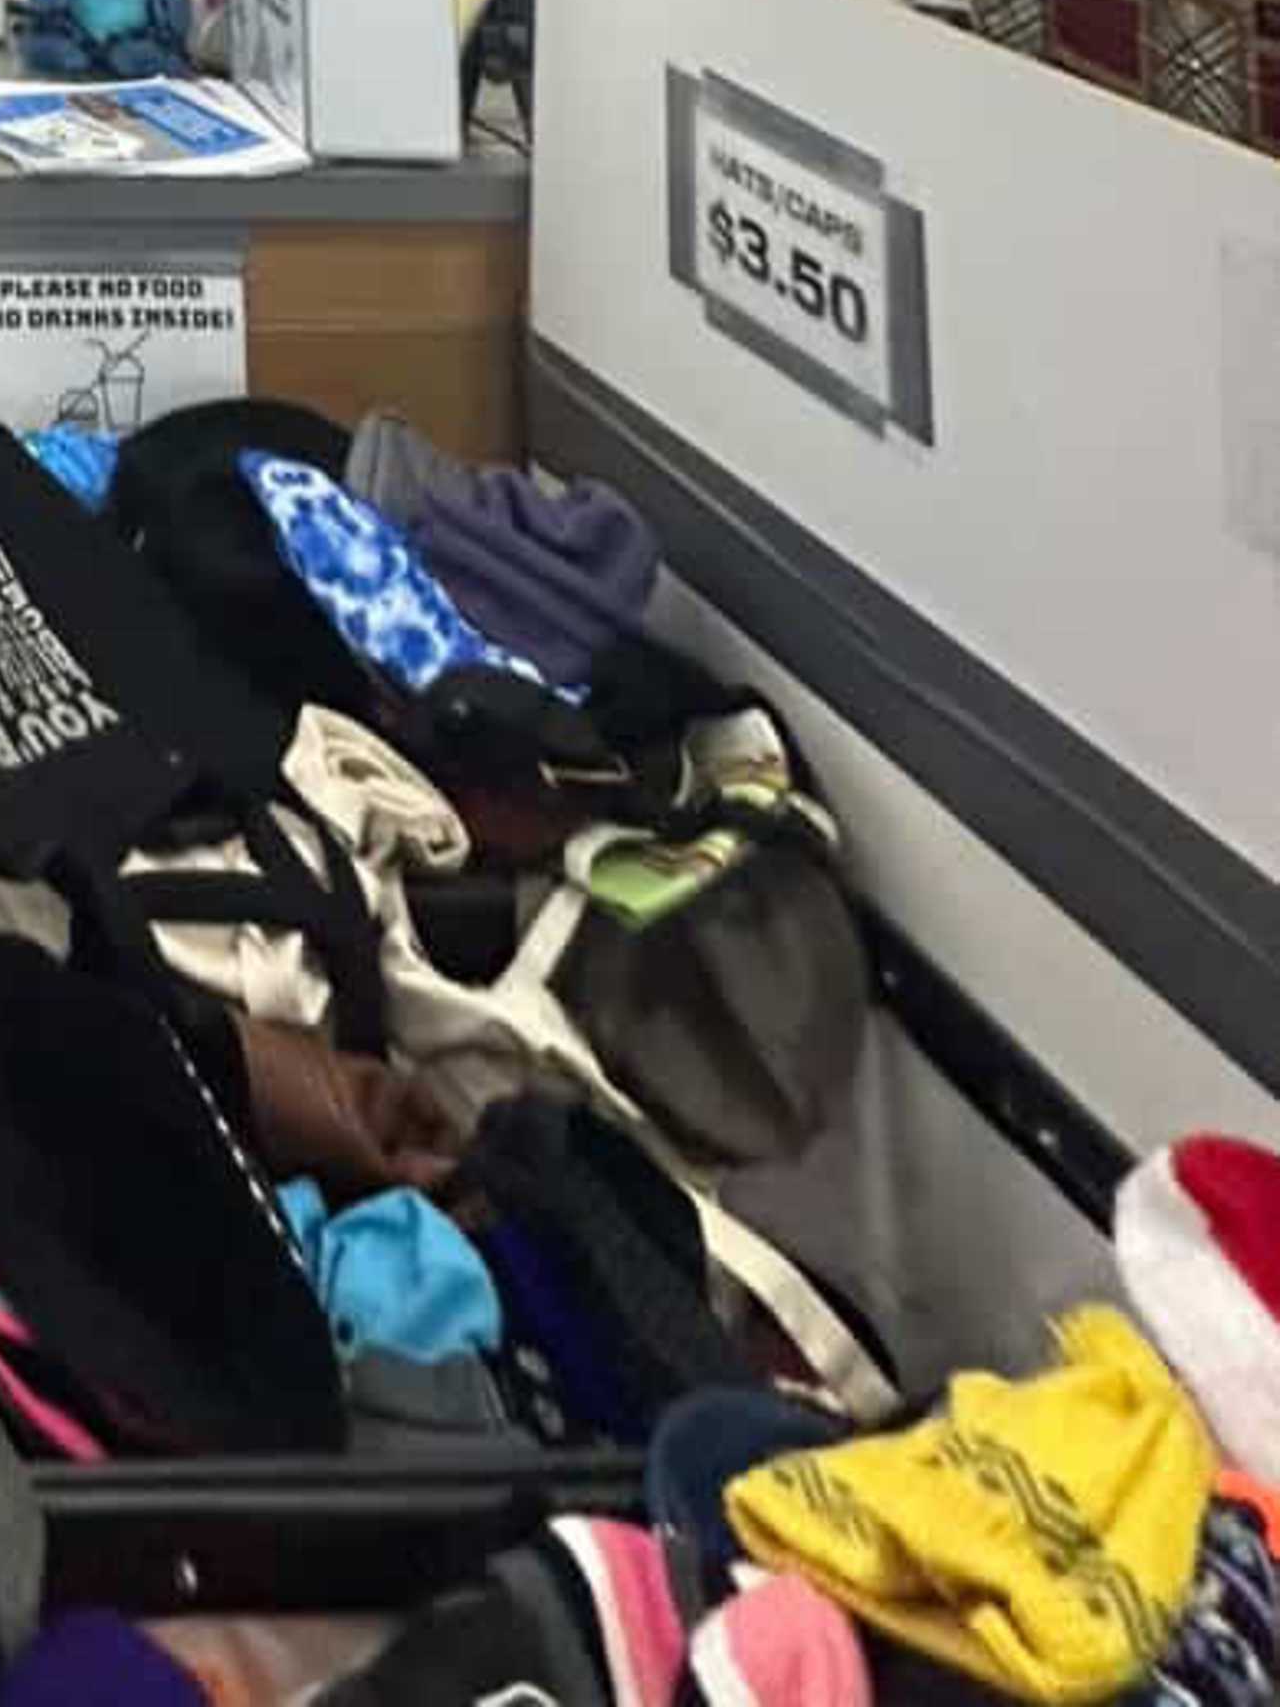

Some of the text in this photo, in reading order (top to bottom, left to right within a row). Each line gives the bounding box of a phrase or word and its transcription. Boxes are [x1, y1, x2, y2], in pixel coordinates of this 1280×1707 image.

[709, 143, 864, 259] HATS/CAPS
[0, 278, 204, 299] PLEASE NO FOOD
[707, 197, 869, 344] $3.50
[28, 308, 126, 329] DRINKS
[131, 309, 234, 330] INSIDE!
